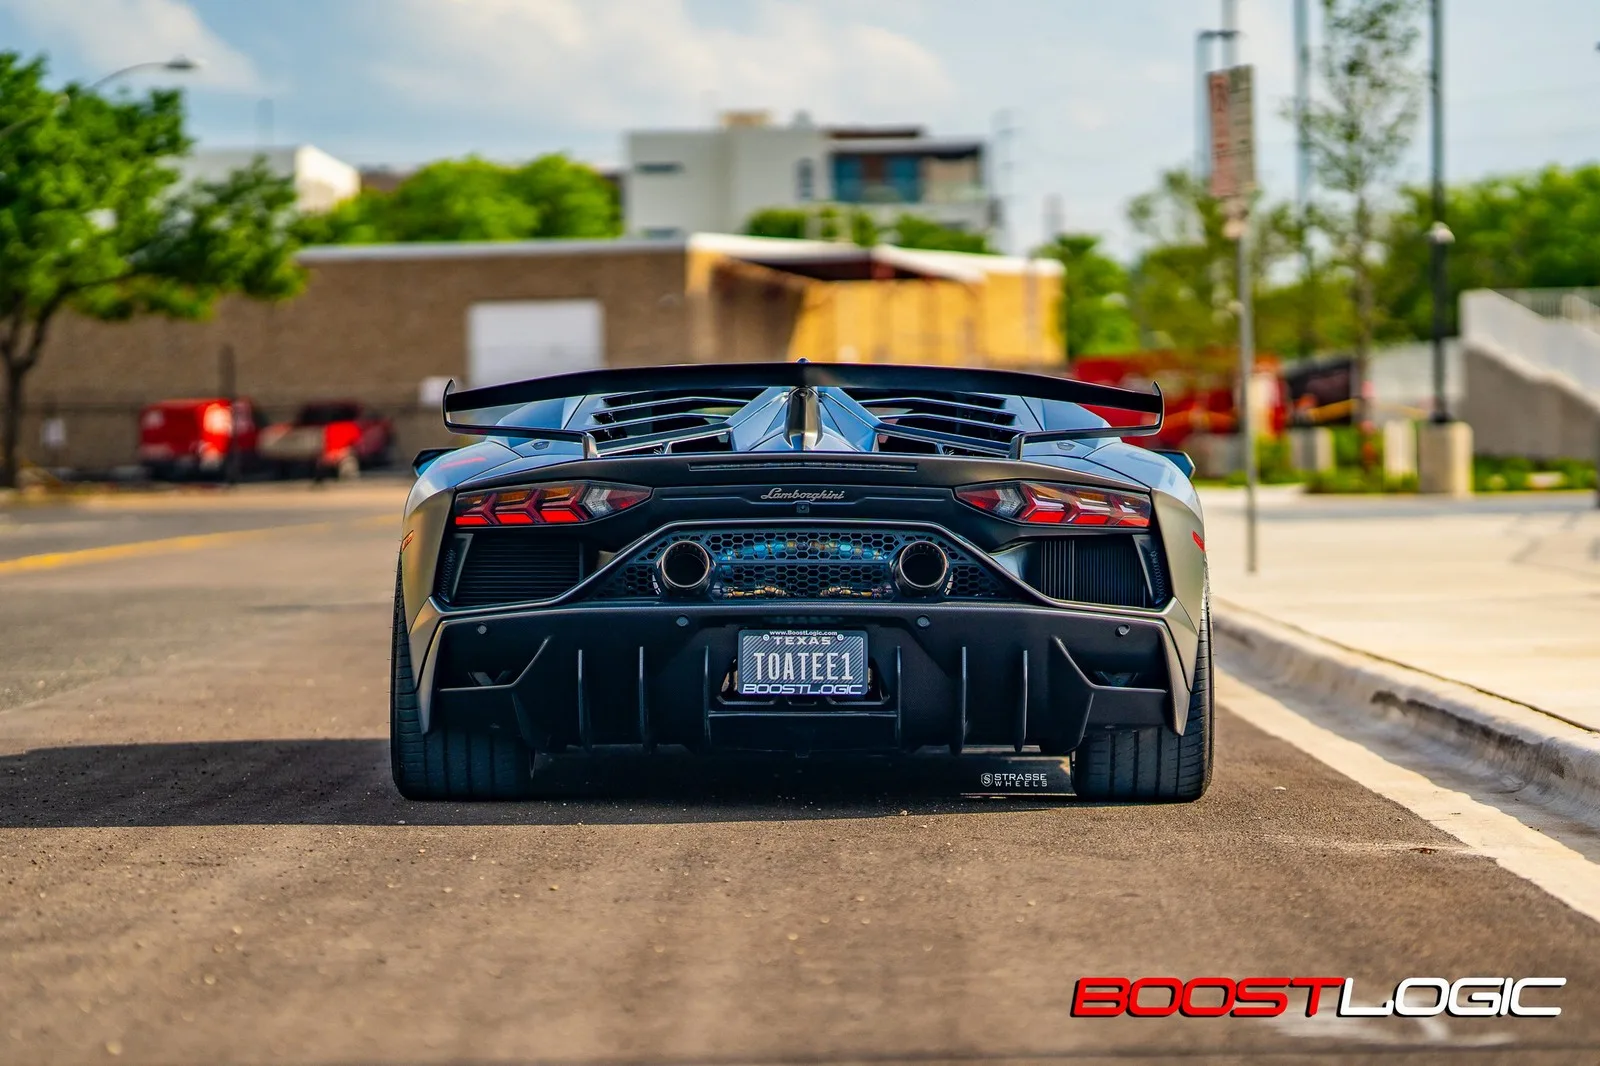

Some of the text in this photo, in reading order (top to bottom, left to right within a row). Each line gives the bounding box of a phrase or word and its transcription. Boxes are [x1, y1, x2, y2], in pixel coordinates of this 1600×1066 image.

[760, 487, 845, 502] Lamborghini
[773, 636, 831, 645] TEXAS
[742, 683, 863, 694] BOOSTLOGIC
